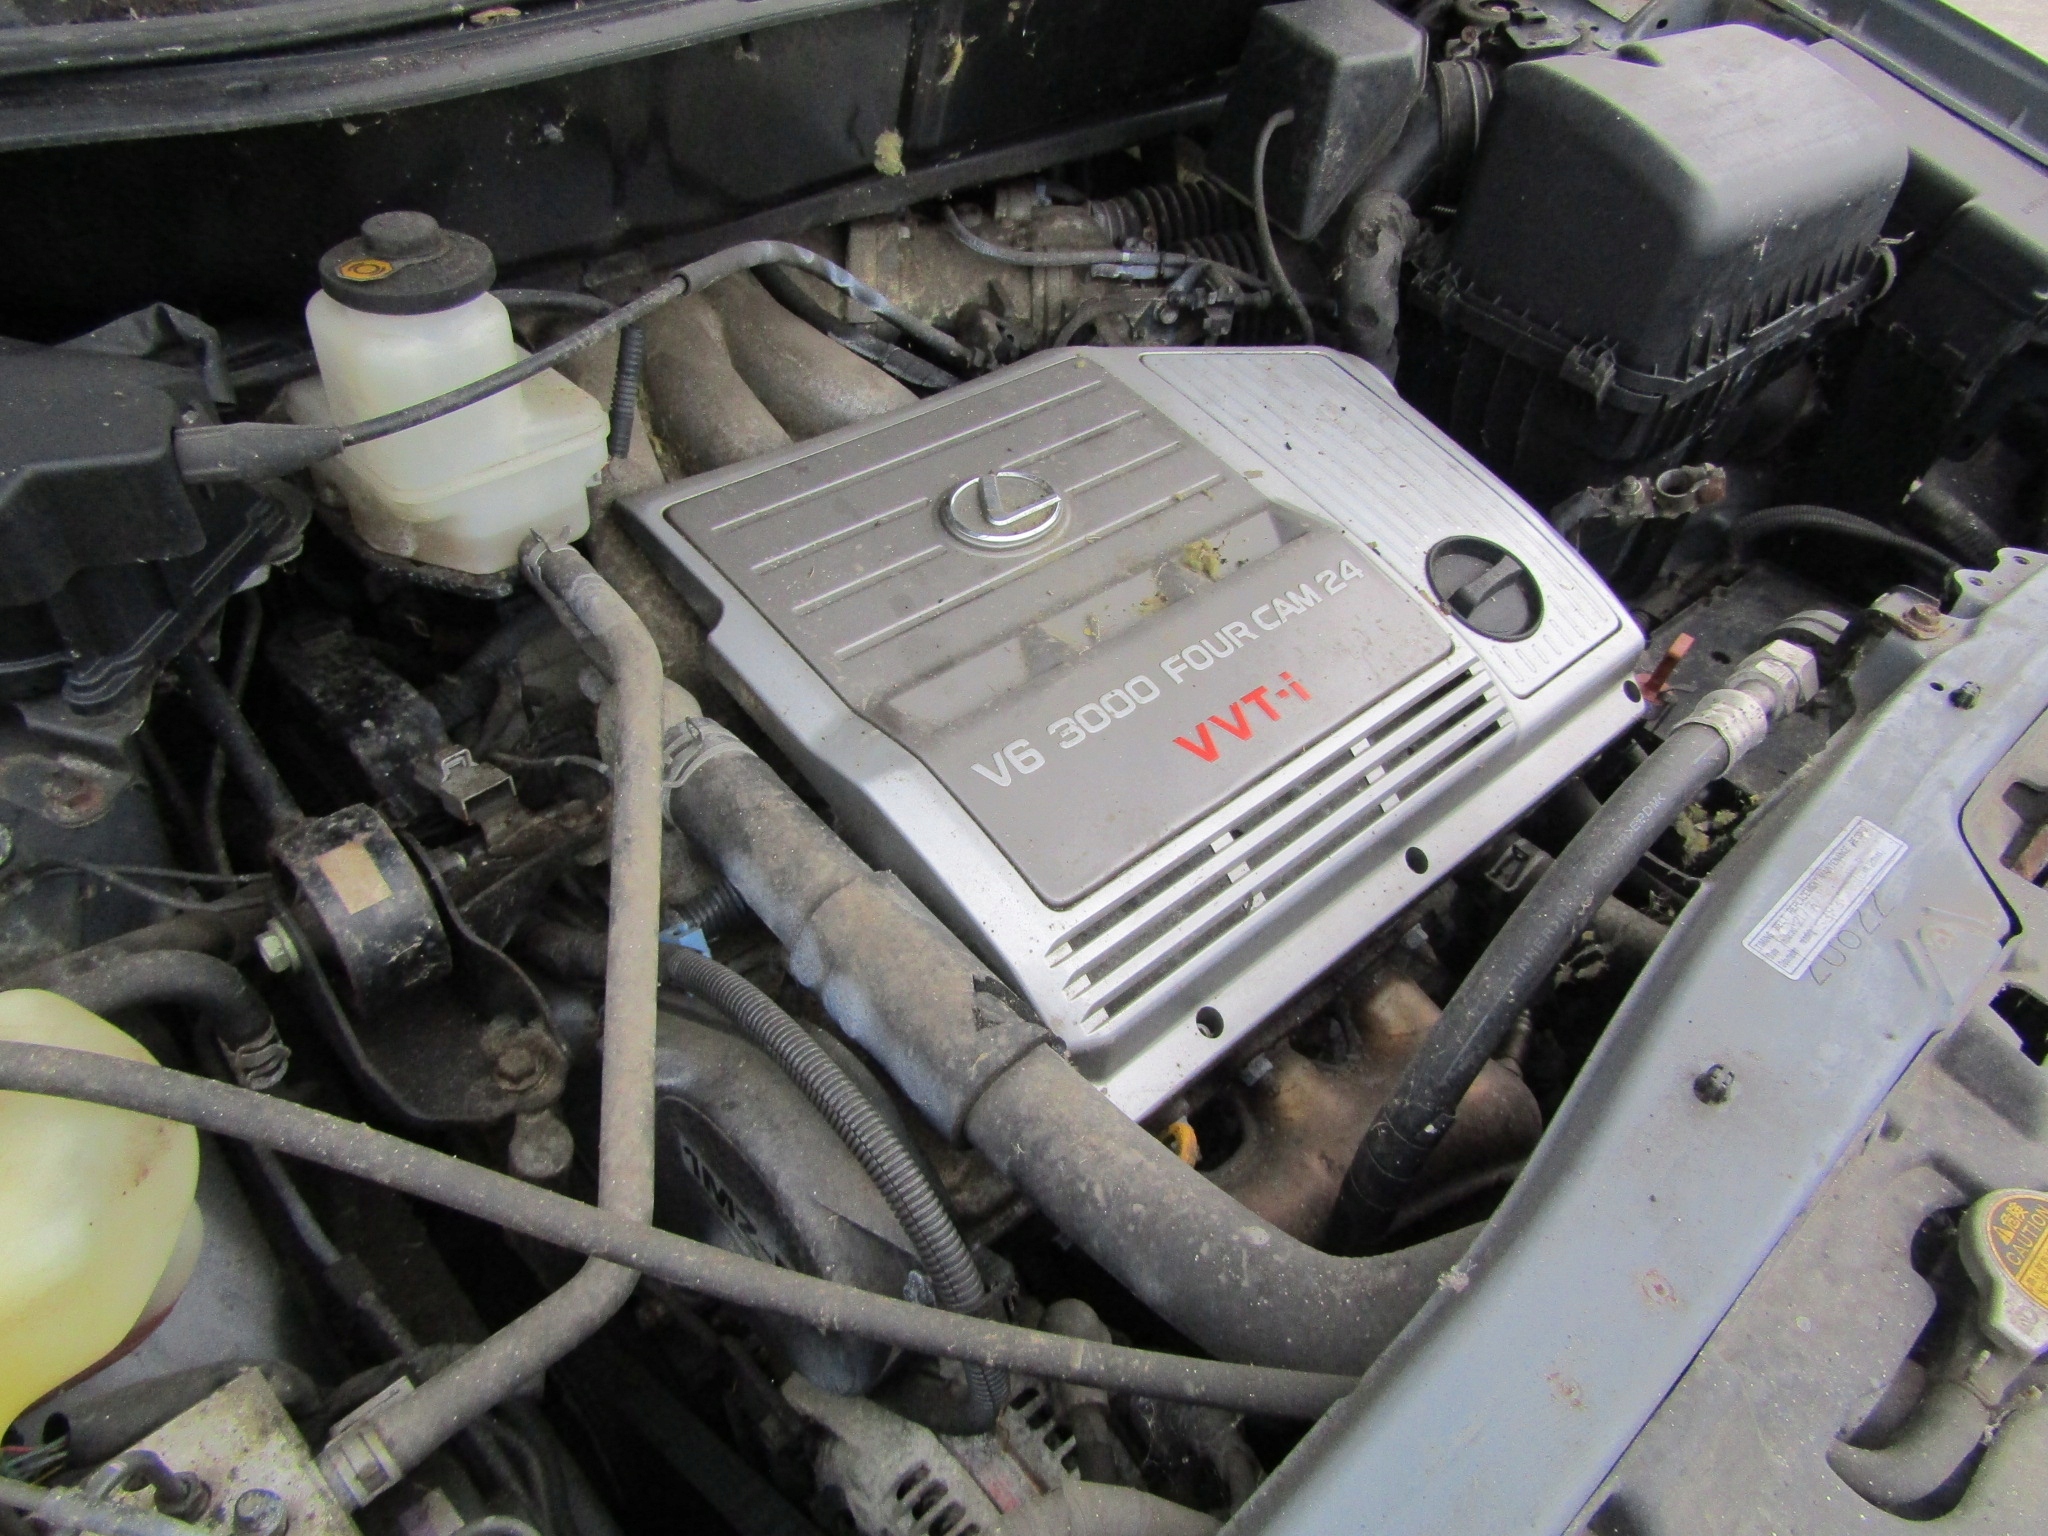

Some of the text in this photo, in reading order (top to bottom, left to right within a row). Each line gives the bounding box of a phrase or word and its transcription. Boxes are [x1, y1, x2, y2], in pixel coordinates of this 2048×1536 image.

[971, 559, 1364, 787] V6 3000 FOUR CAM 24
[1172, 671, 1312, 763] VVT-i
[2005, 1203, 2048, 1267] CAUTION
